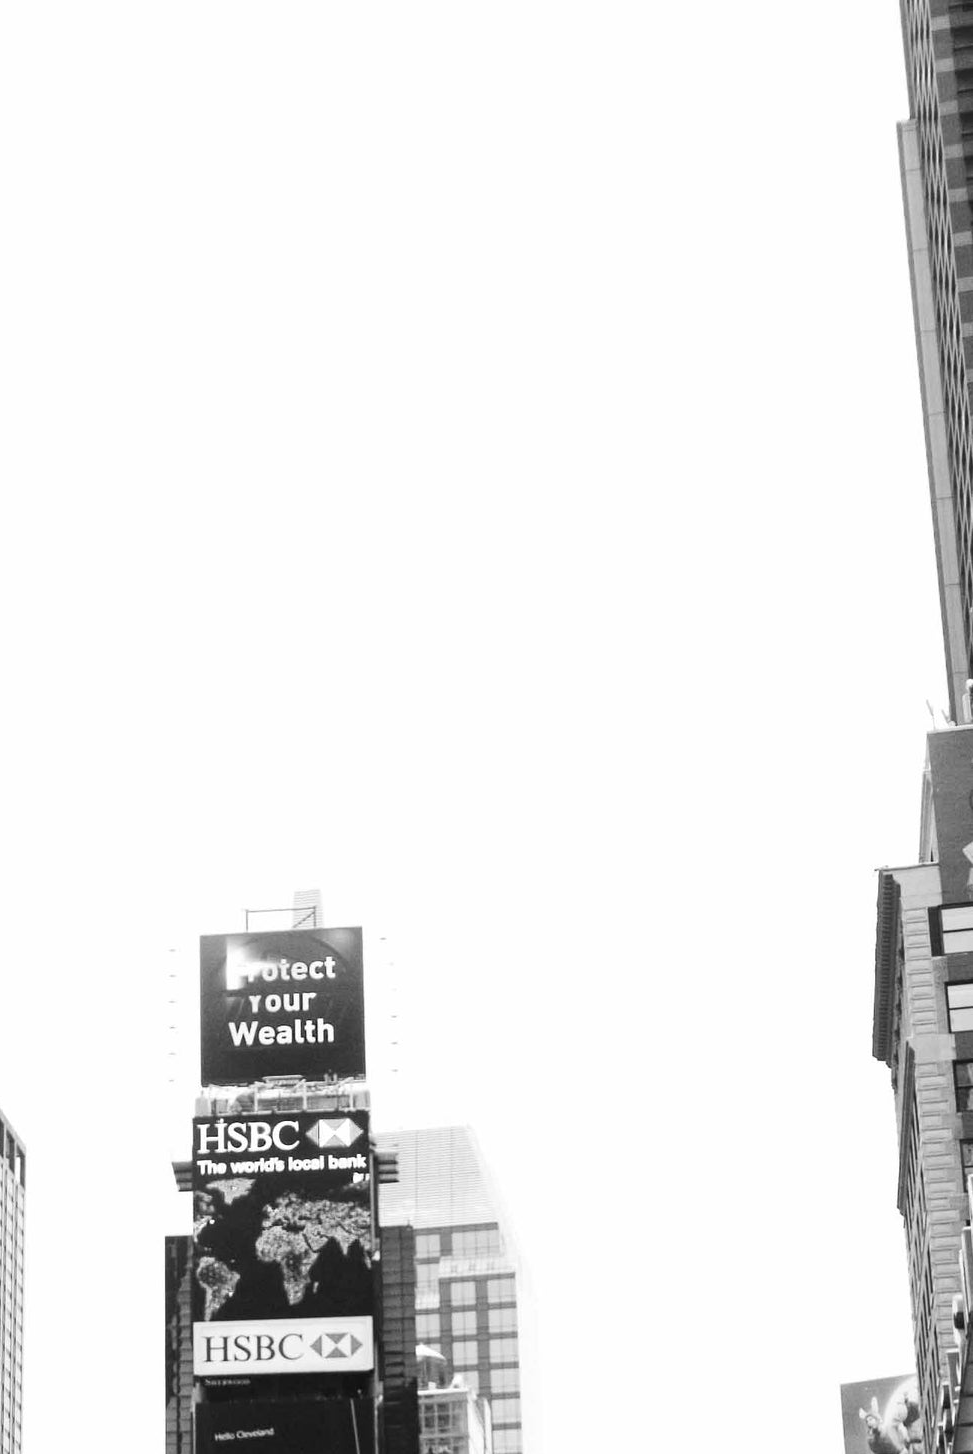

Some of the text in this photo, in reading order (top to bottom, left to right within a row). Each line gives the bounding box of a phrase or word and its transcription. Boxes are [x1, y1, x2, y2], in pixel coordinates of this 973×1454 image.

[233, 956, 337, 983] rotect
[228, 1018, 335, 1046] Wealth
[197, 1120, 300, 1154] HSBC
[197, 1153, 367, 1175] The world's local bank
[201, 1333, 304, 1362] HSBC
[214, 1430, 236, 1442] Hello
